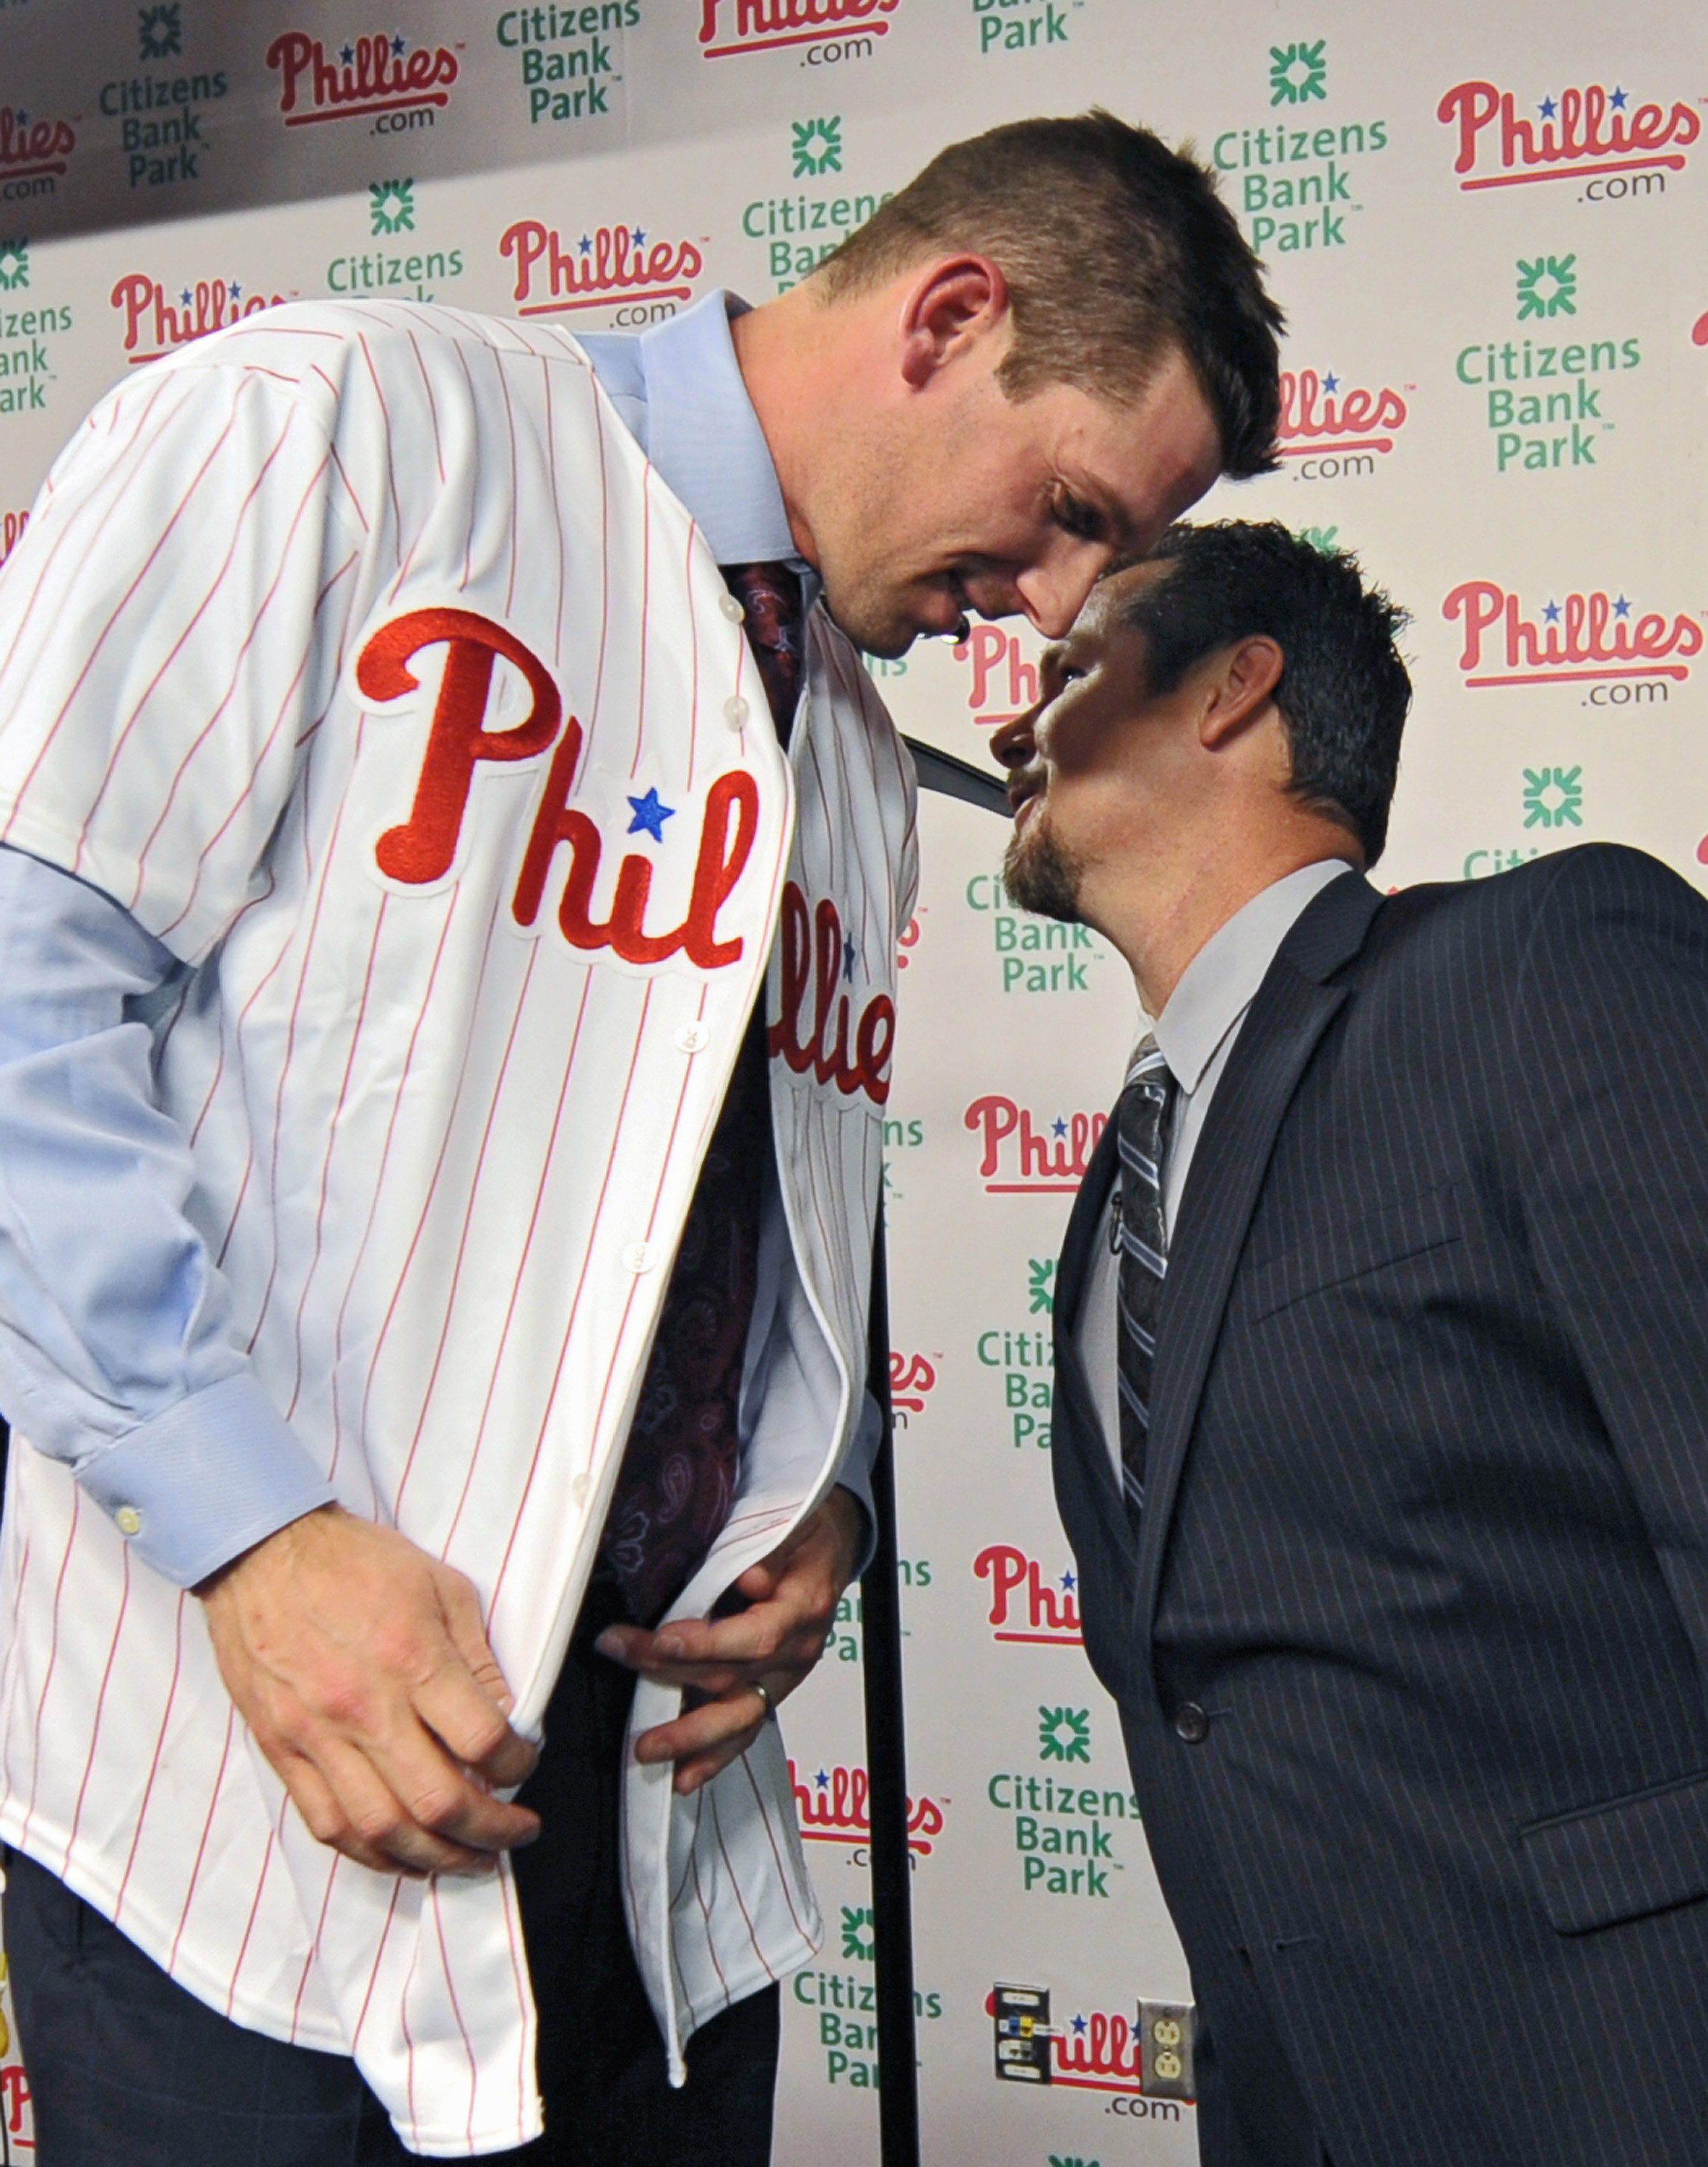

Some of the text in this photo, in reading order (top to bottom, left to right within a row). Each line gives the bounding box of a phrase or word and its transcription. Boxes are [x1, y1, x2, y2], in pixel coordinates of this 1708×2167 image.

[497, 0, 640, 46] Citizens
[981, 3, 1068, 53] Park
[266, 32, 458, 111] Phillies
[523, 37, 612, 85] Bank
[800, 38, 872, 67] .com
[100, 72, 227, 116] Citizens
[531, 77, 608, 124] Park
[122, 105, 201, 152] Bank
[369, 110, 434, 136] .com
[1436, 80, 1701, 174] Phillies
[129, 144, 199, 188] Park
[1213, 121, 1387, 172] Citizens
[1244, 161, 1350, 212] Bank
[1577, 172, 1665, 204] .com
[1252, 206, 1345, 254] Park
[329, 250, 463, 293] Citizens
[500, 220, 702, 300] Phillies
[609, 300, 675, 329] .com
[1455, 338, 1641, 384] Citizens
[1487, 379, 1601, 428] Bank
[1293, 455, 1374, 482] .com
[1497, 425, 1596, 472] Park
[1442, 581, 1704, 670] Phillies
[1581, 682, 1668, 706] .com
[357, 607, 759, 969] Phil
[994, 917, 1093, 952] Bank
[1003, 953, 1088, 992] Park
[1015, 1816, 1113, 1859] Bank
[1023, 1856, 1109, 1898] Park
[1105, 2097, 1180, 2121] .com
